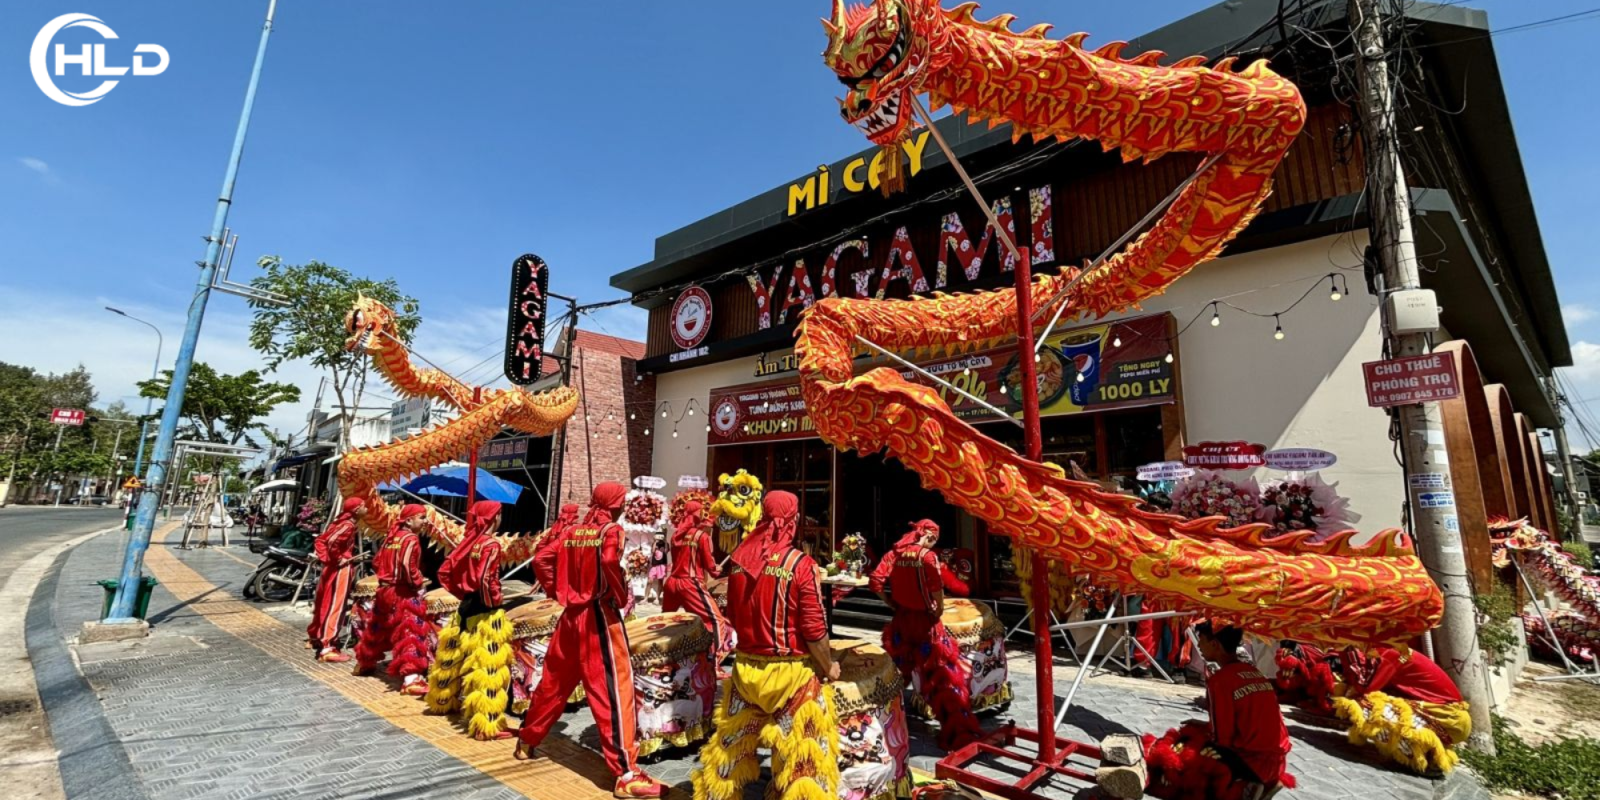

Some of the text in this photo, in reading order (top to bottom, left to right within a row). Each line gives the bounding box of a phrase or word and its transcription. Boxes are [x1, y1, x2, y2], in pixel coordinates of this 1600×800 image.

[787, 164, 830, 217] MÌ
[746, 184, 1055, 330] YAGAMI
[515, 259, 545, 379] YAGAMI
[1374, 356, 1442, 376] CHO THUÊ
[787, 386, 800, 396] 102
[1099, 378, 1171, 401] 1000 LY
[1371, 372, 1451, 392] PHÒNG TRỌ
[1435, 387, 1454, 397] 178
